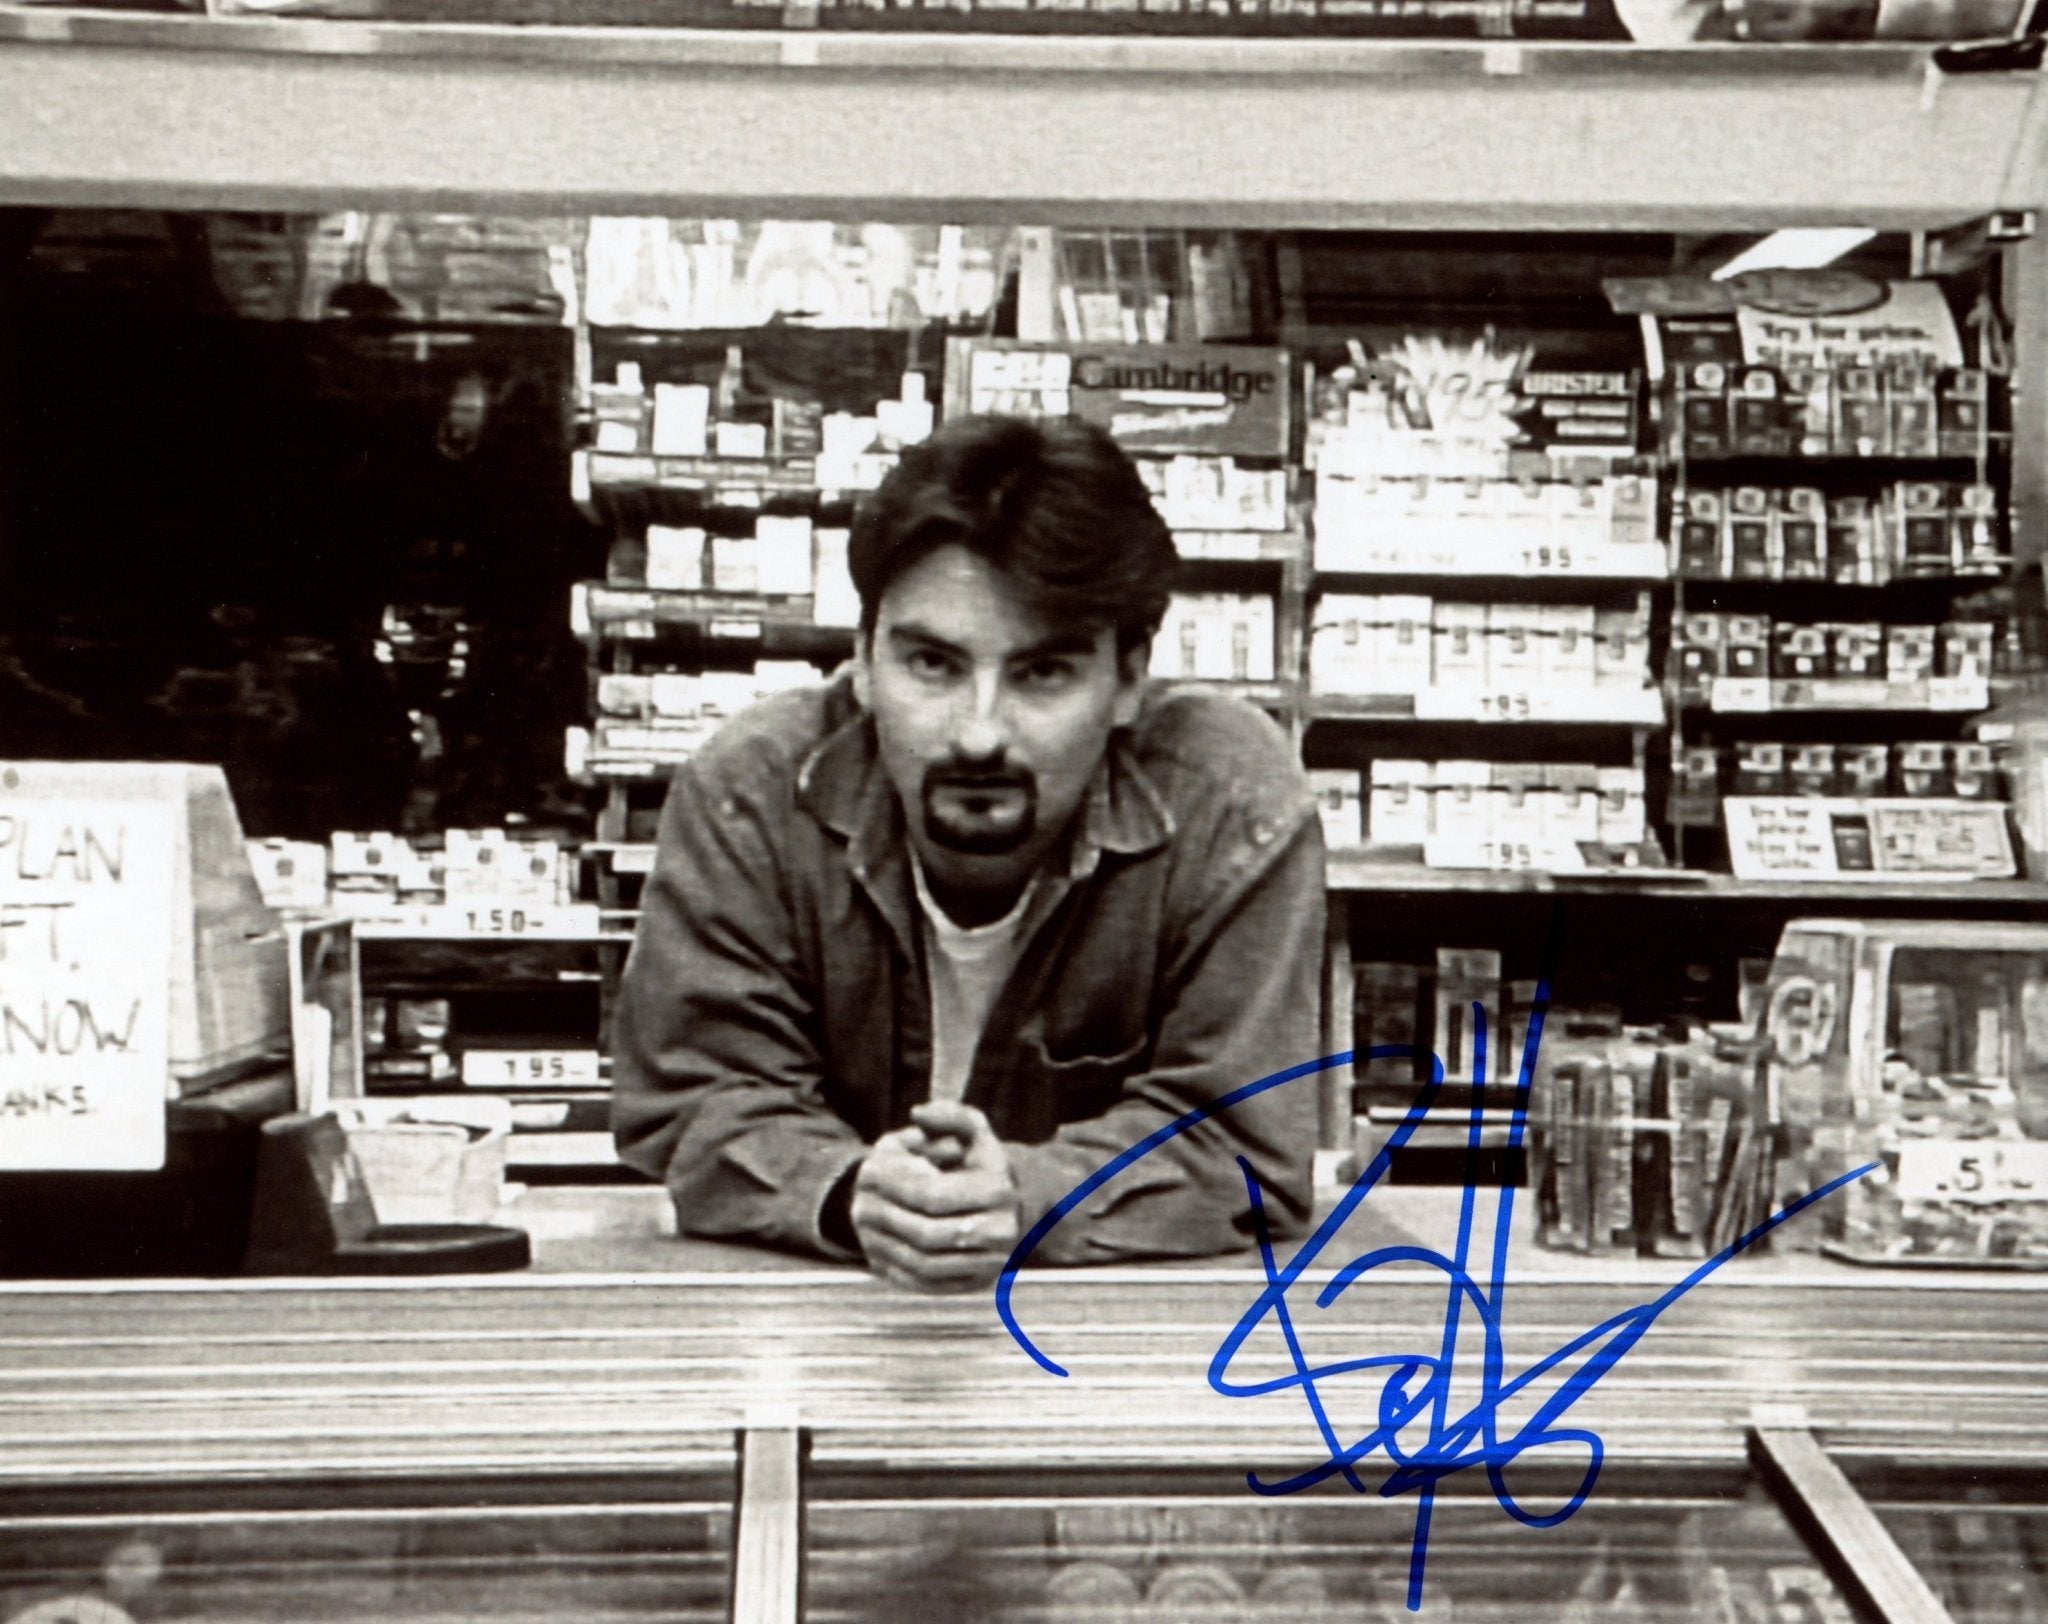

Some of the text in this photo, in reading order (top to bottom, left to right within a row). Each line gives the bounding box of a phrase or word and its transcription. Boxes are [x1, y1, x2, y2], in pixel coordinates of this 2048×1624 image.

[1071, 356, 1276, 405] Cambridge
[0, 814, 125, 883] PLAN
[2, 993, 142, 1056] NOW
